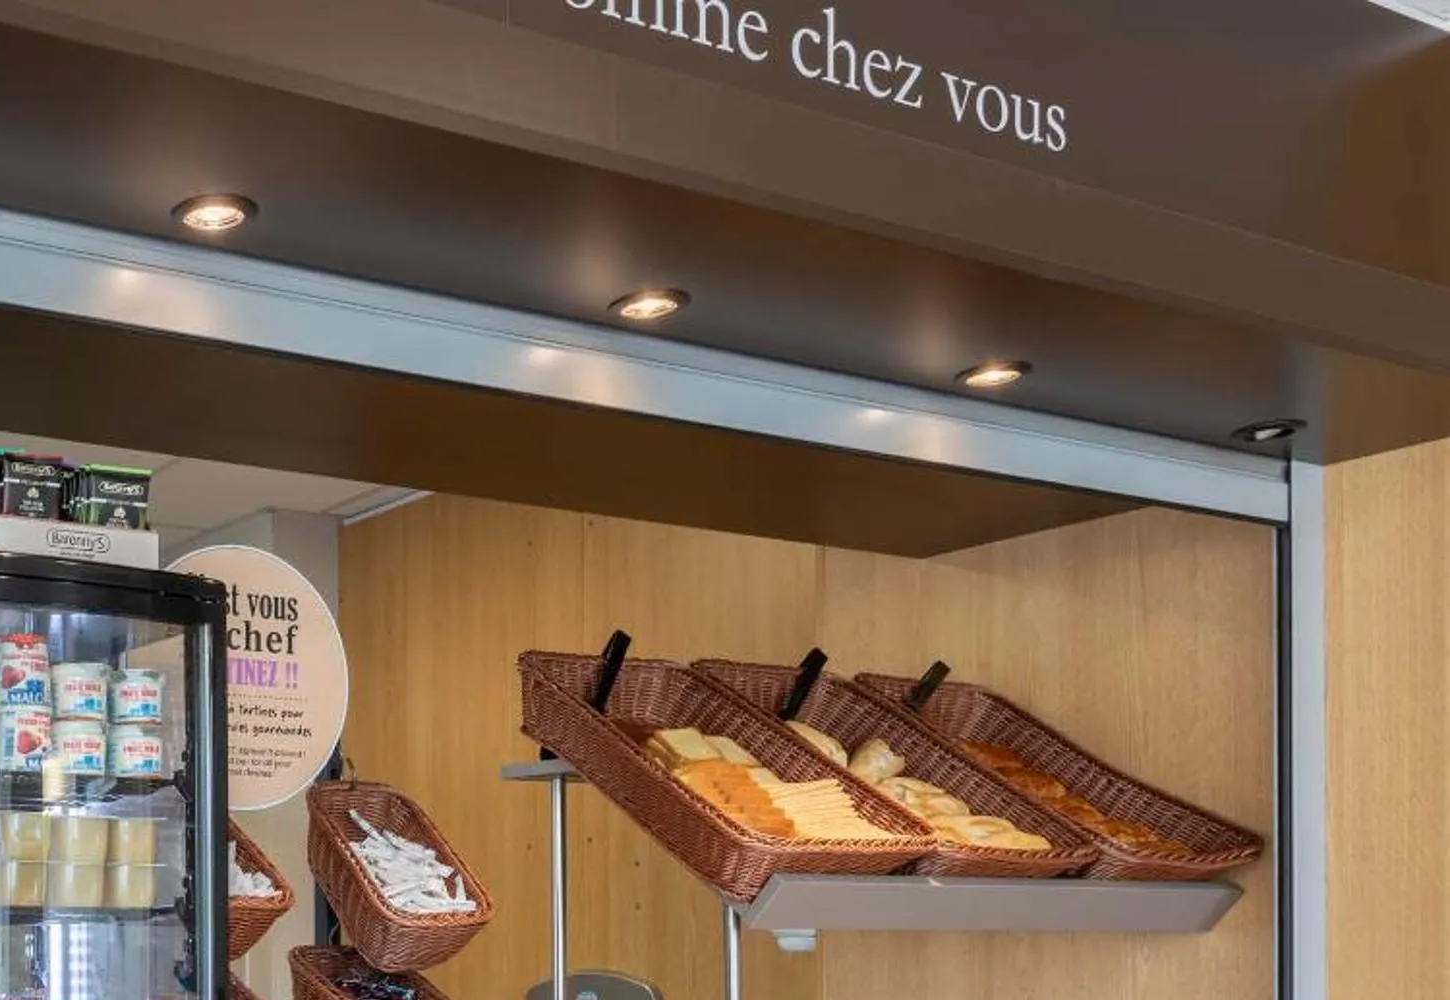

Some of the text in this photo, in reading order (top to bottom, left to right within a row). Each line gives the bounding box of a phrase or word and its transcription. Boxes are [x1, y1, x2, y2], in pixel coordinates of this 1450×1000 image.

[791, 7, 924, 109] chez
[940, 71, 1067, 152] vous
[247, 593, 299, 621] vous
[227, 620, 298, 654] chef
